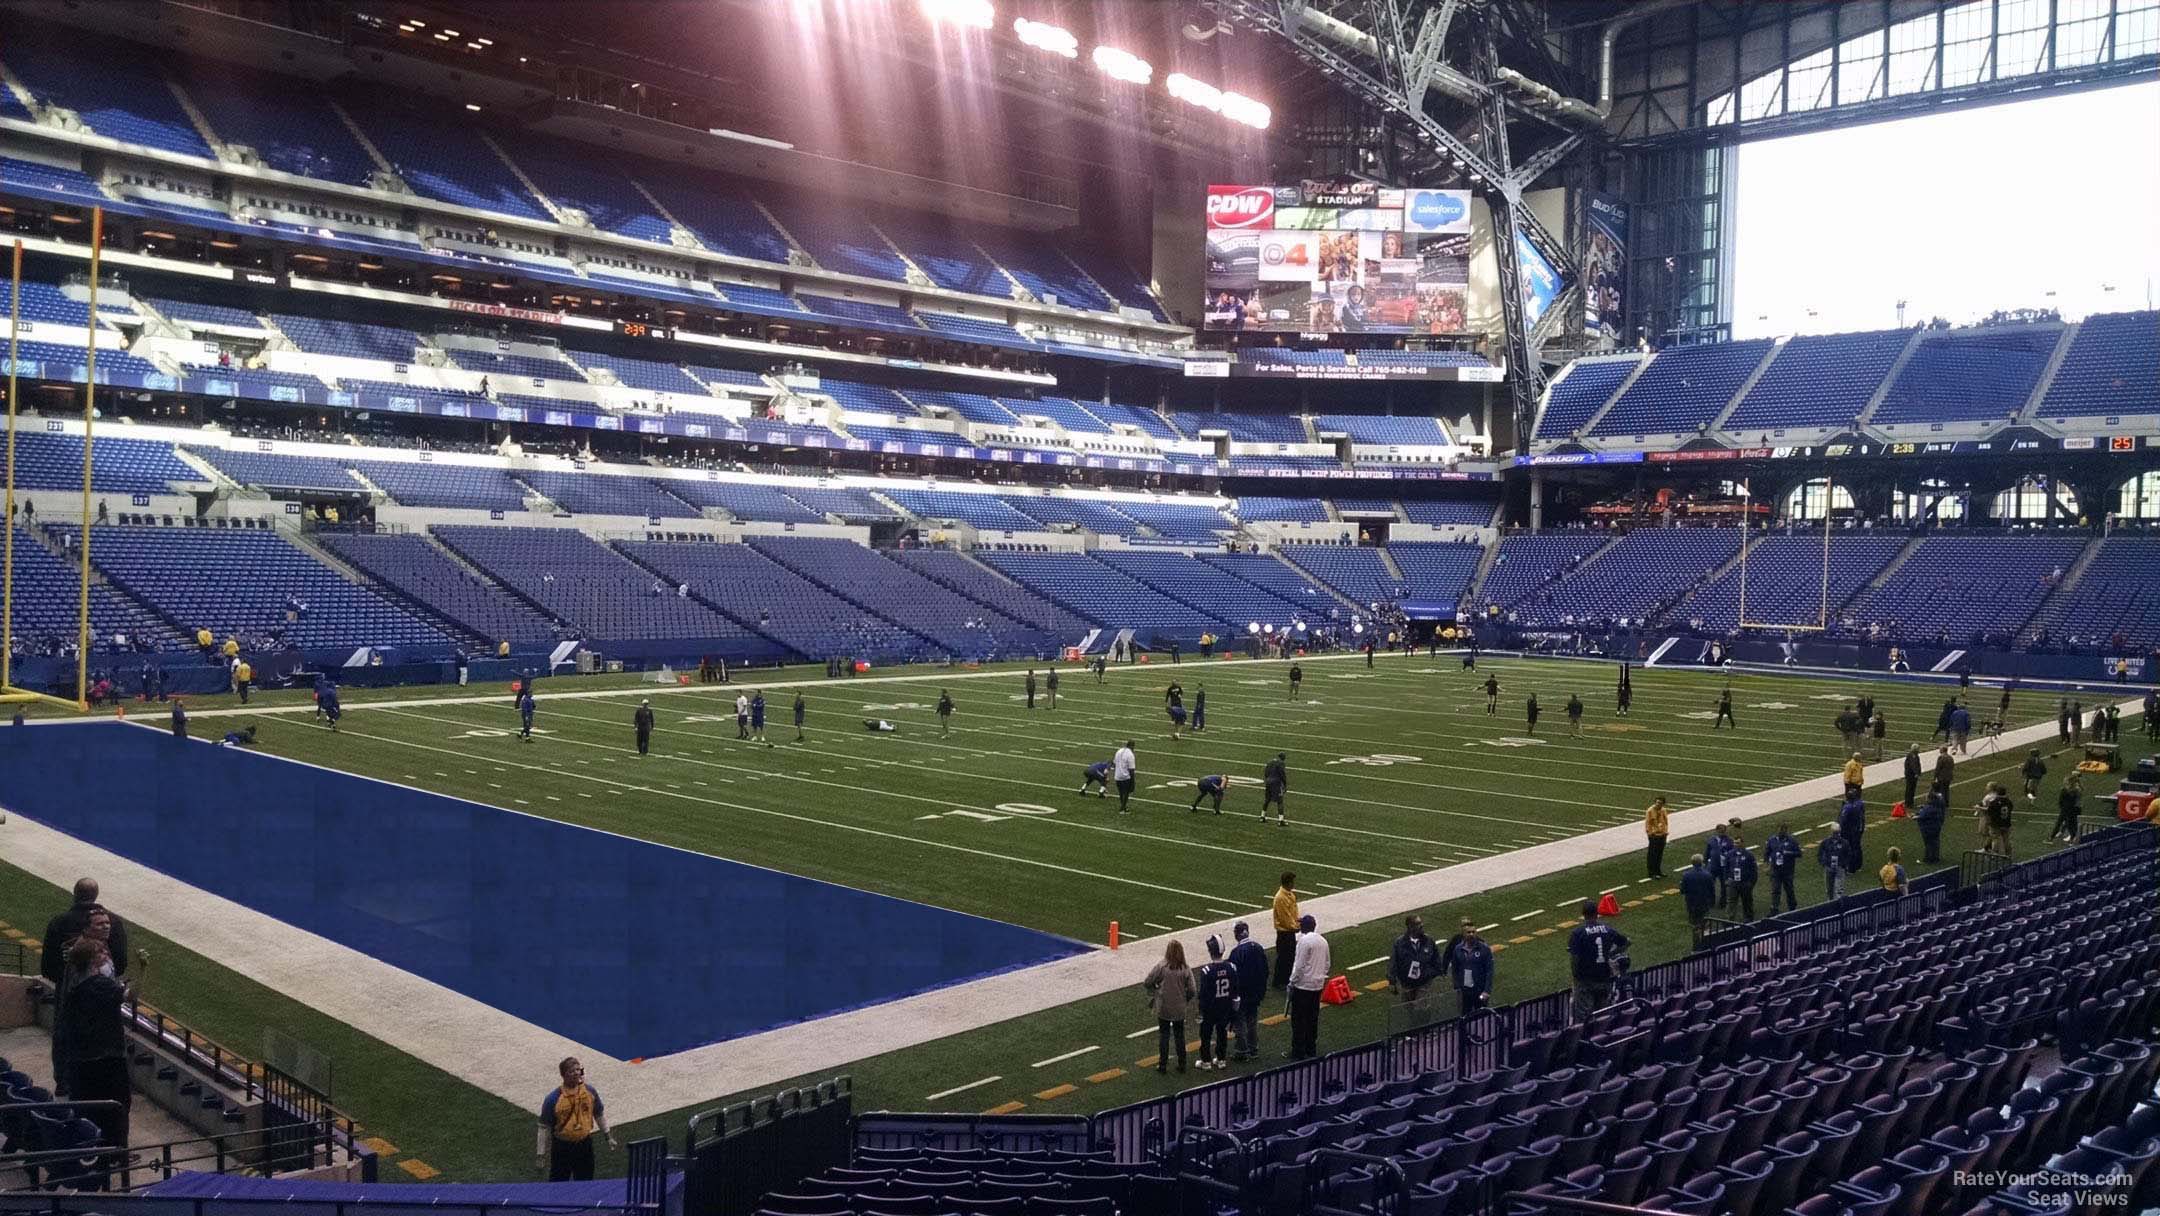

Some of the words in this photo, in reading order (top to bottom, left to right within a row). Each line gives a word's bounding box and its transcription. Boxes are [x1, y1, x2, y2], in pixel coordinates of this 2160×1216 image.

[1206, 194, 1265, 214] CDW
[1316, 195, 1363, 205] STADIUM
[1417, 204, 1461, 217] salesforce
[1285, 243, 1309, 266] 4
[246, 274, 276, 285] verizon
[623, 321, 645, 336] 2:39
[1255, 363, 1269, 372] For
[1270, 364, 1295, 374] Sales,
[1296, 364, 1318, 373] Parts
[1327, 365, 1357, 374] Service
[1358, 365, 1373, 374] Call
[1893, 443, 1915, 454] 2:39
[2113, 437, 2131, 449] 25
[1805, 446, 1812, 456] 0
[1861, 445, 1868, 454] 0
[1555, 455, 1586, 463] LIGHT
[1268, 470, 1300, 478] OFFICIAL
[1301, 470, 1328, 478] BACKUP
[1330, 470, 1354, 479] POWER
[133, 496, 149, 505] 137
[942, 803, 1057, 822] 10
[2125, 800, 2140, 814] G
[1595, 937, 1605, 963] 1
[1215, 978, 1230, 998] 12
